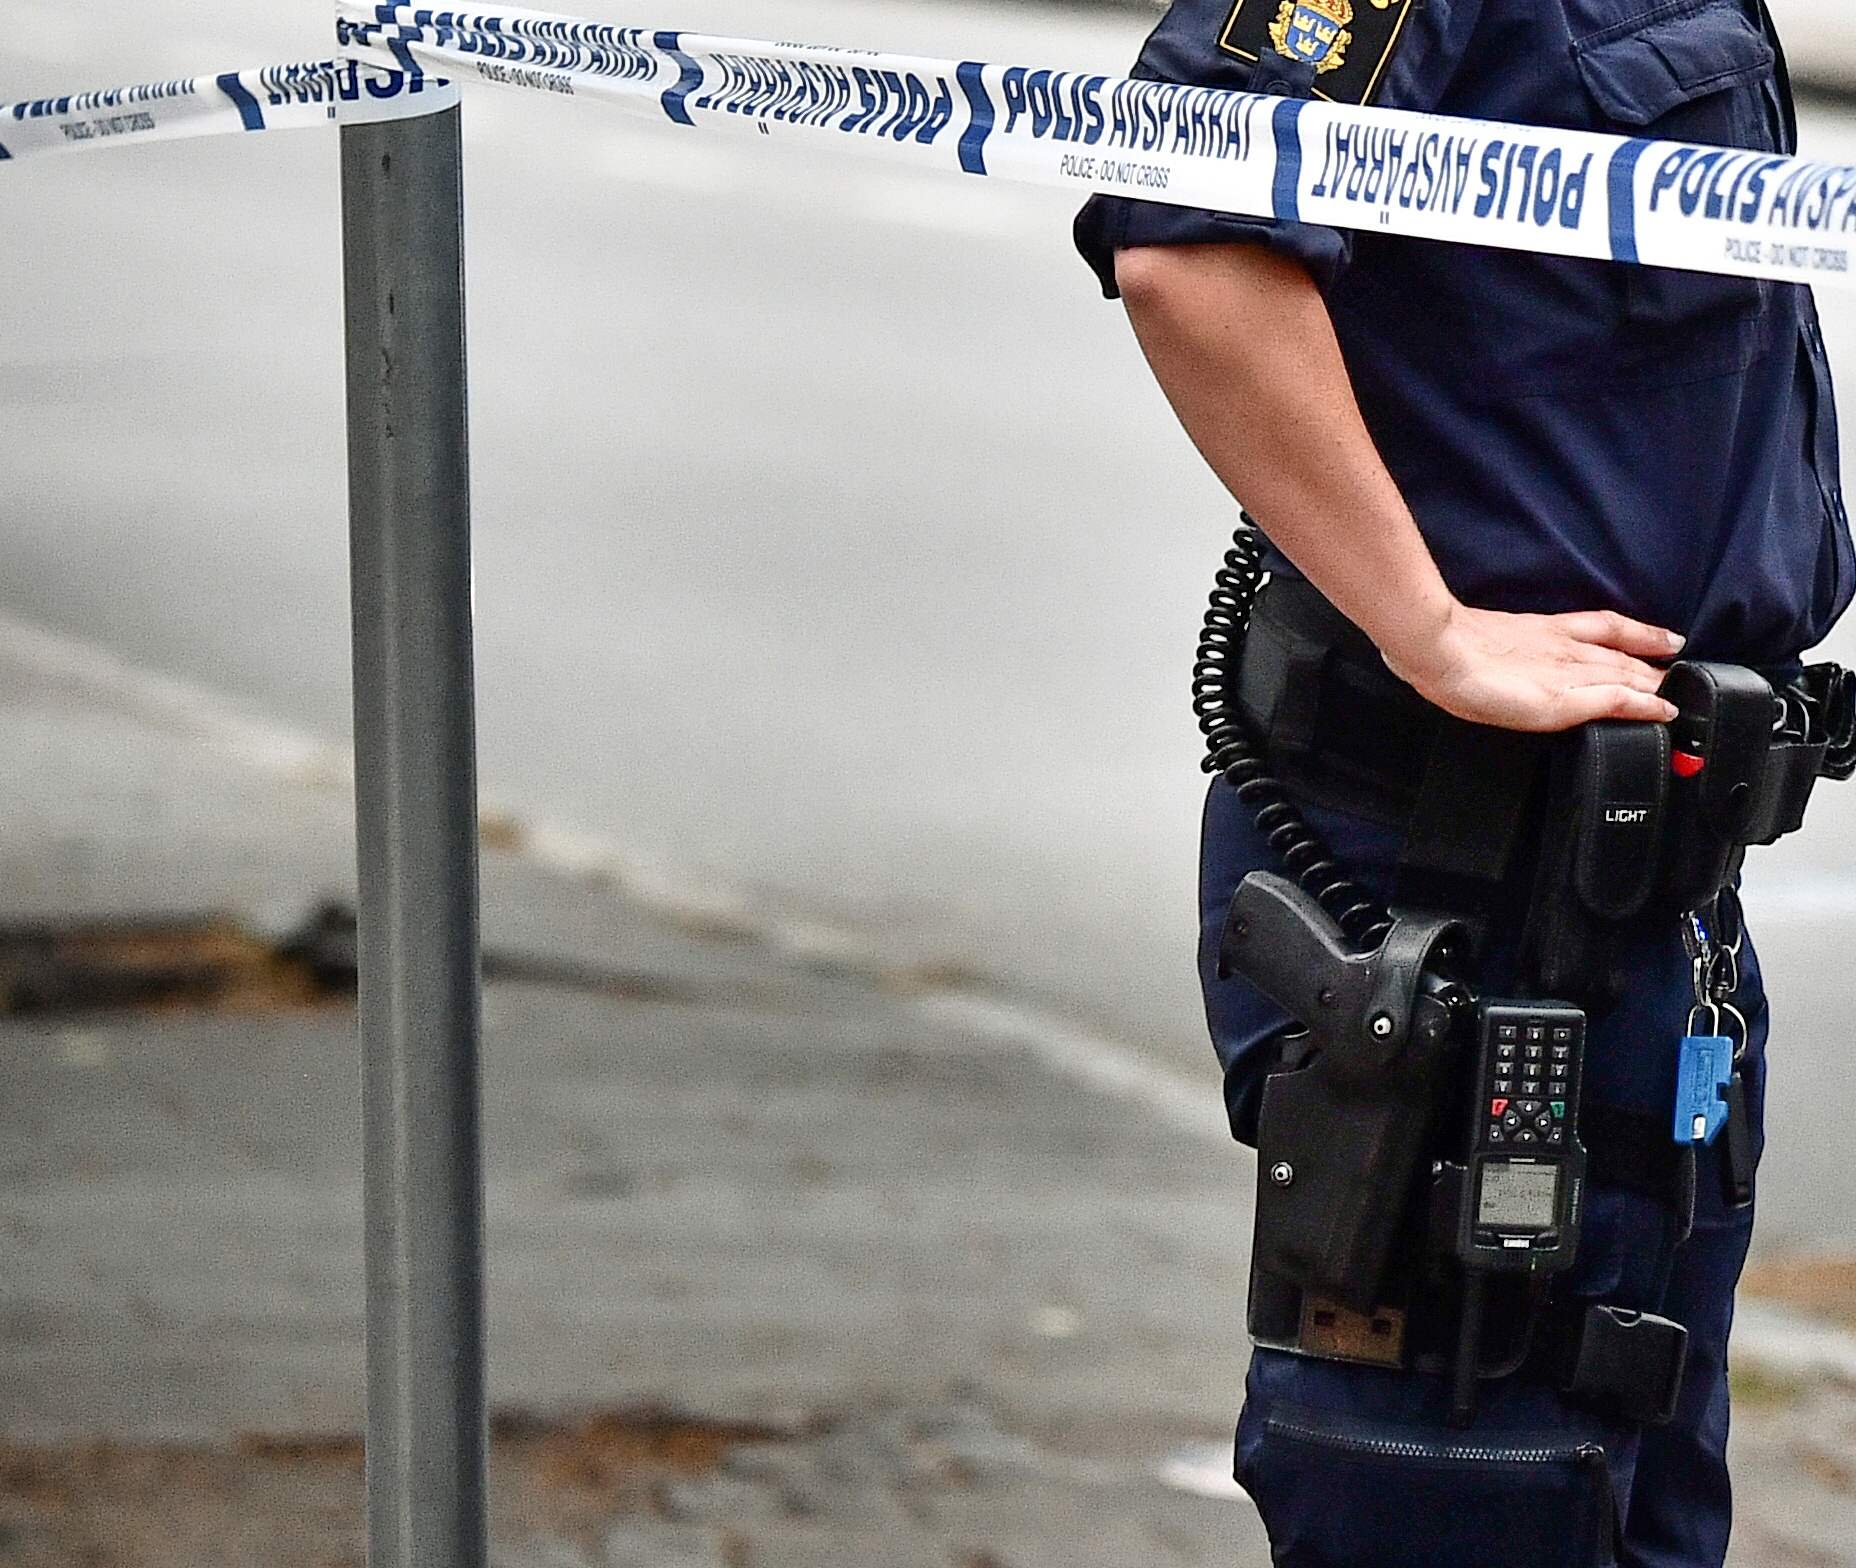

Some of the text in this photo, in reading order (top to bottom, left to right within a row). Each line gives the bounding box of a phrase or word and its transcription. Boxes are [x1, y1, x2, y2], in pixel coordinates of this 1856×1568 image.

[839, 66, 953, 145] POLIS
[1002, 66, 1111, 145] POLIS
[1060, 154, 1095, 179] POLICE
[1100, 160, 1115, 181] DO
[1115, 162, 1137, 184] NOT
[1137, 164, 1170, 189] CROSS
[1311, 121, 1595, 230] POLIS AVSPÄRRAT
[1649, 148, 1791, 224] POLIS
[1605, 809, 1647, 822] LIGHT
